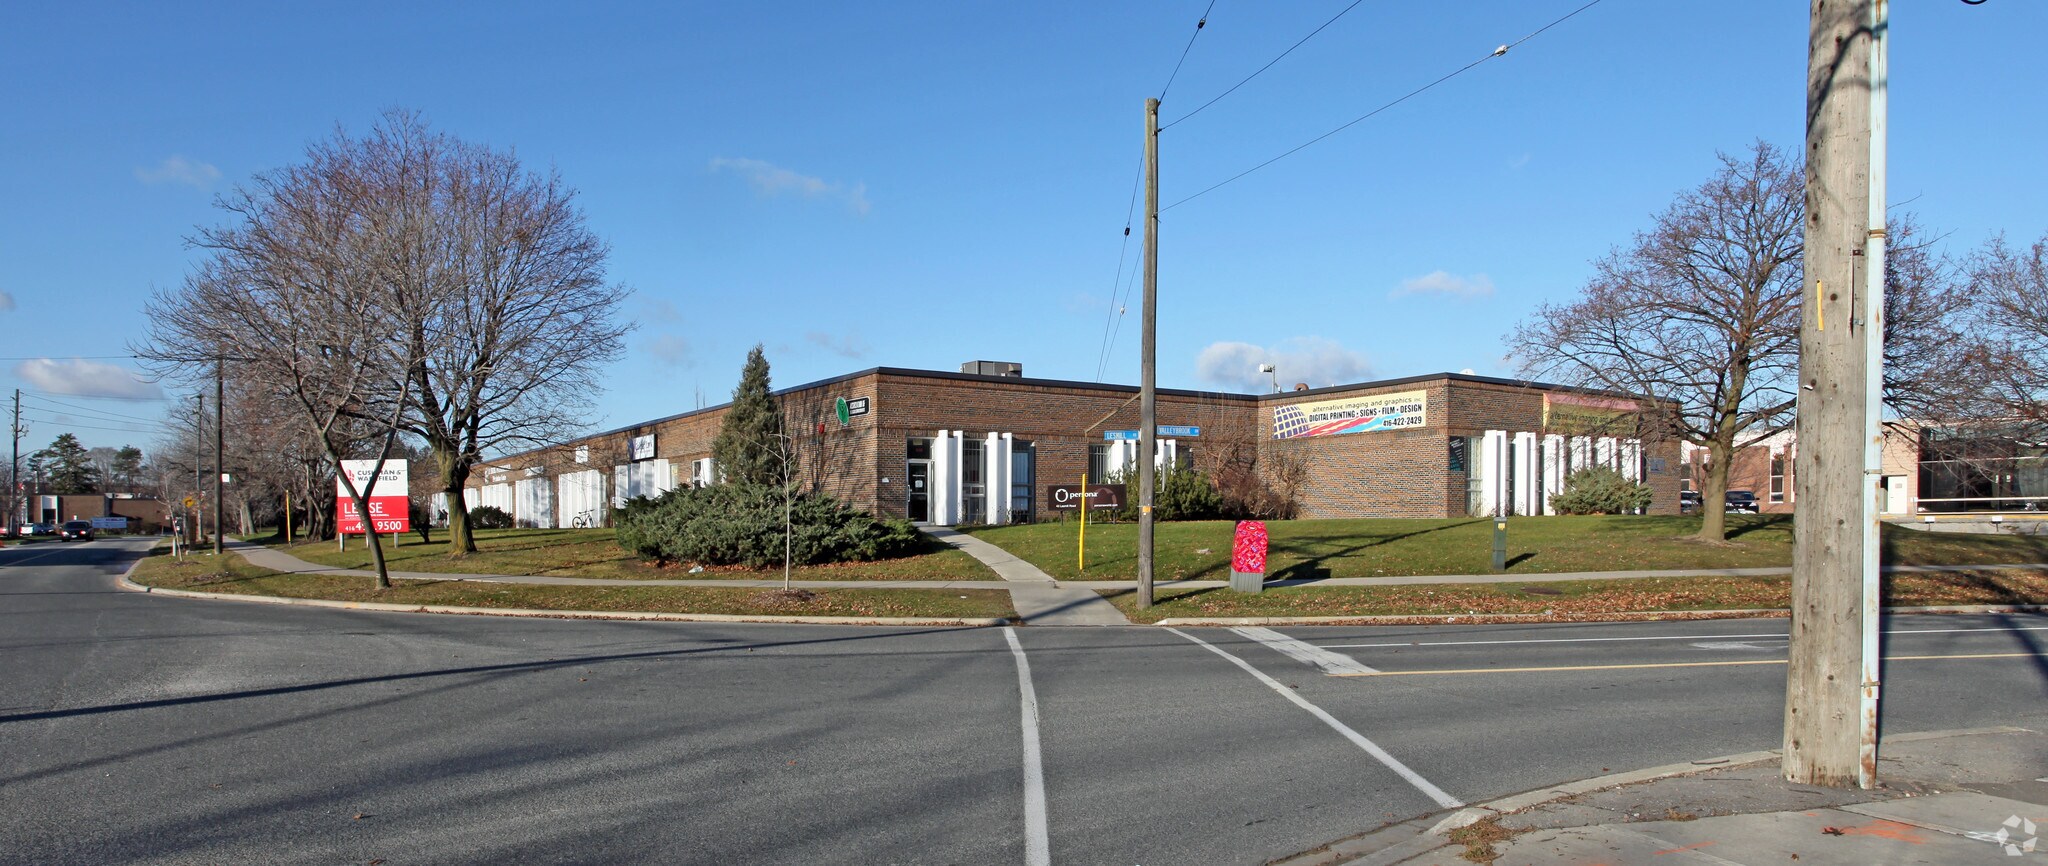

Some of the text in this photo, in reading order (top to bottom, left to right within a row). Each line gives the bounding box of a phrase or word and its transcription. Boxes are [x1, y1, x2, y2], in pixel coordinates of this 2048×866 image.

[1312, 404, 1343, 412] alternative
[1345, 402, 1369, 410] imaging
[1384, 398, 1412, 406] graphics
[1309, 404, 1422, 422] DIGITAL PRINTING SIGNS FILM DESIGN
[344, 503, 383, 513] LESE
